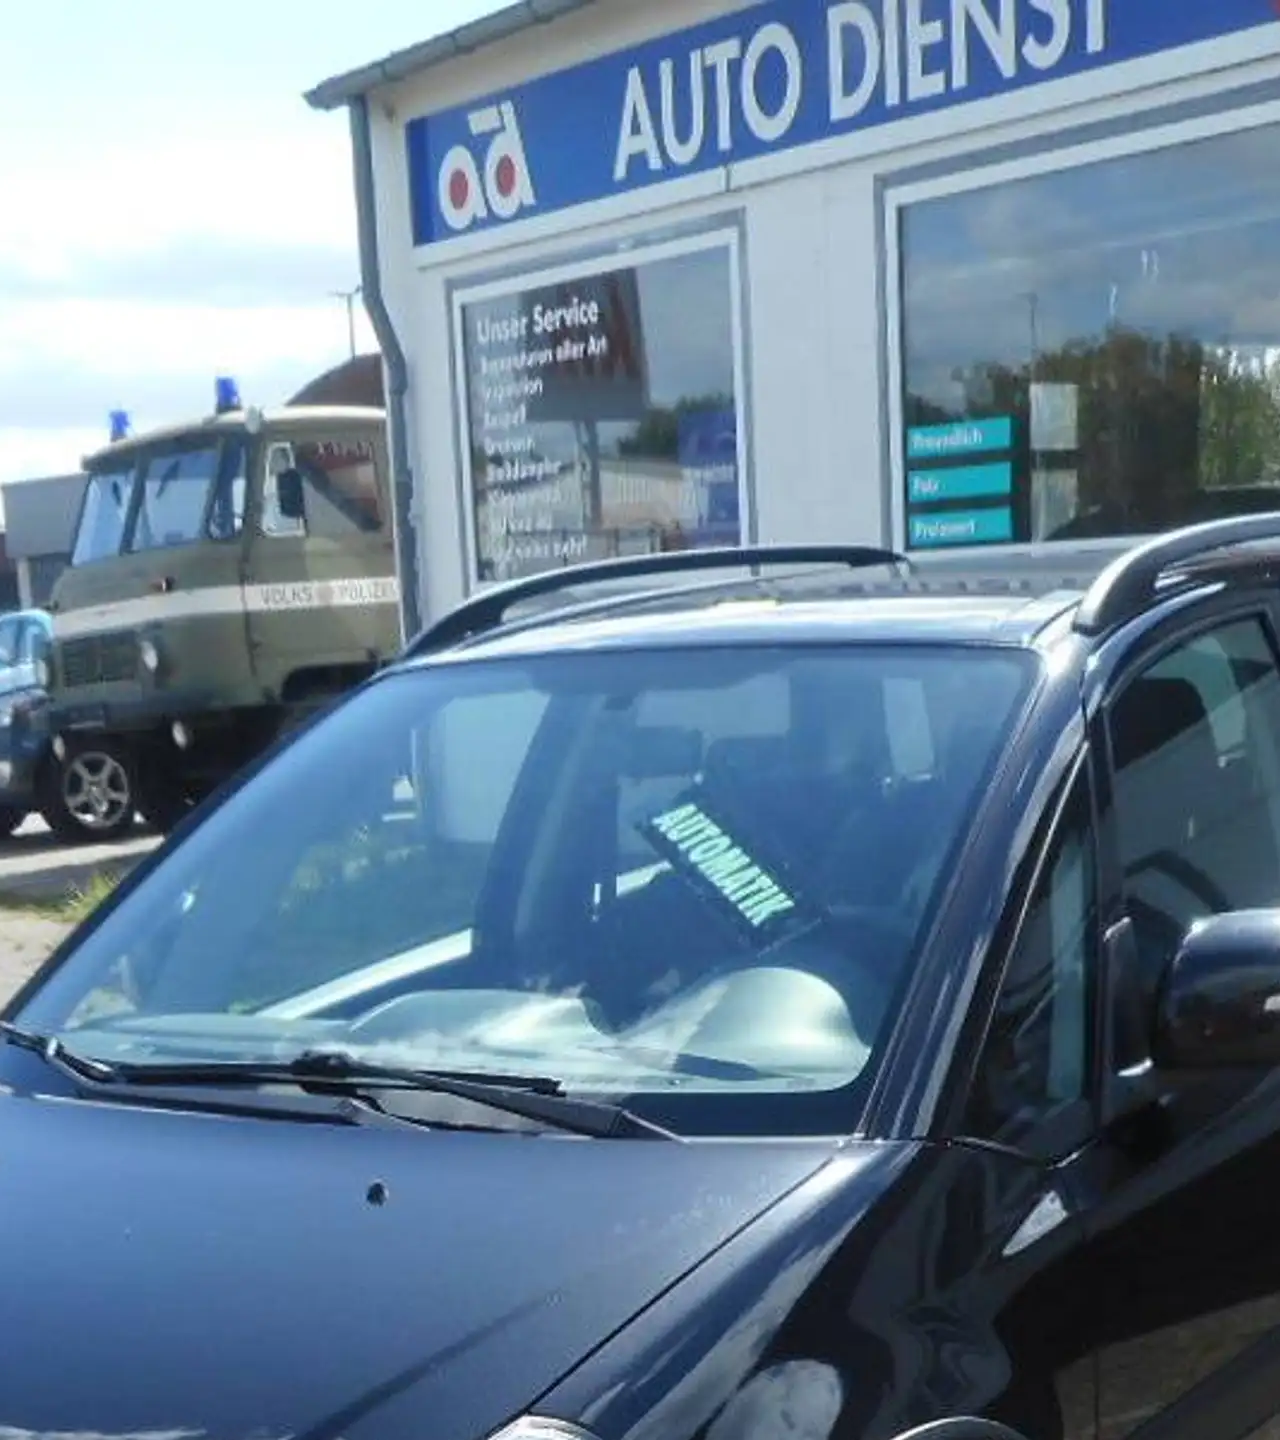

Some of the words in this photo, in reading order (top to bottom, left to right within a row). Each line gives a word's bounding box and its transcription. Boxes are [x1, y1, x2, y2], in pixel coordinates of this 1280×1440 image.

[613, 23, 801, 181] AUTO
[476, 315, 528, 343] Unser
[532, 296, 599, 334] Service
[260, 583, 313, 605] VOLKS
[652, 803, 795, 927] AUTOMATIK
